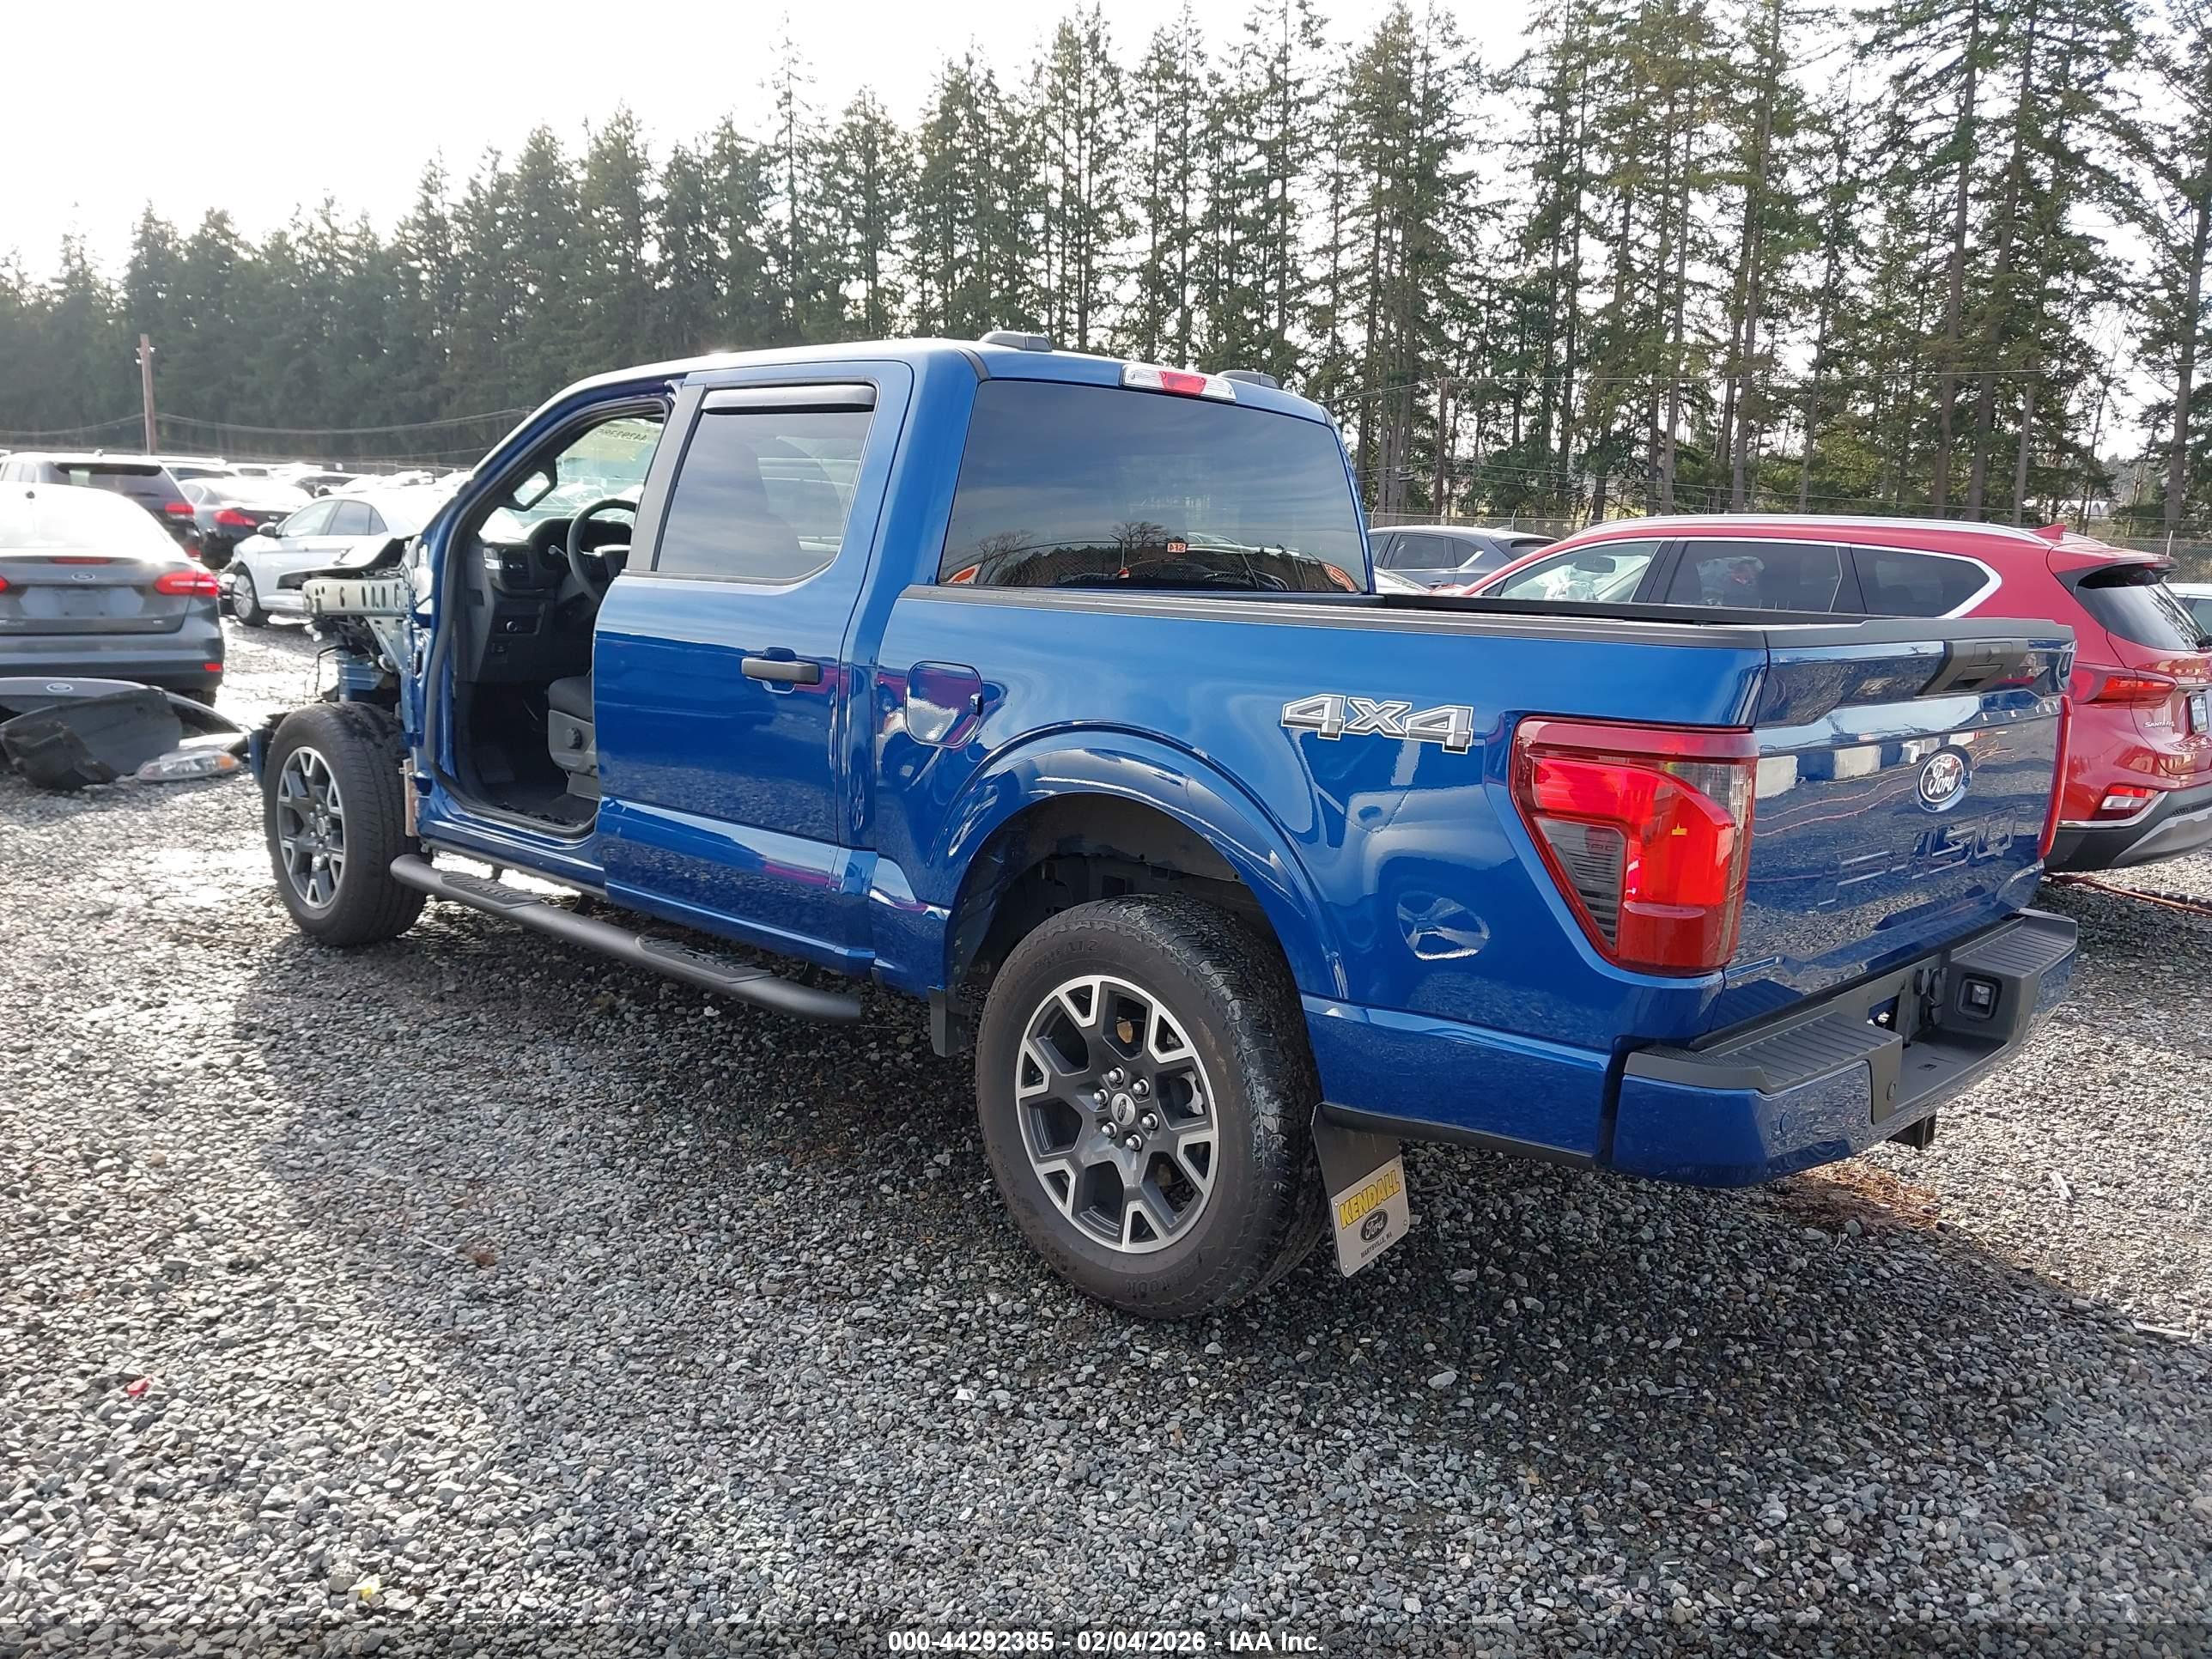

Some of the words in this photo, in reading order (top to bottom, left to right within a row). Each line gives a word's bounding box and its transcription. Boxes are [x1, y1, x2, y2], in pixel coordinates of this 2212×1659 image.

[1928, 761, 1957, 795] Ford
[1339, 1170, 1401, 1230] KENDALL
[1365, 1214, 1384, 1239] Ford
